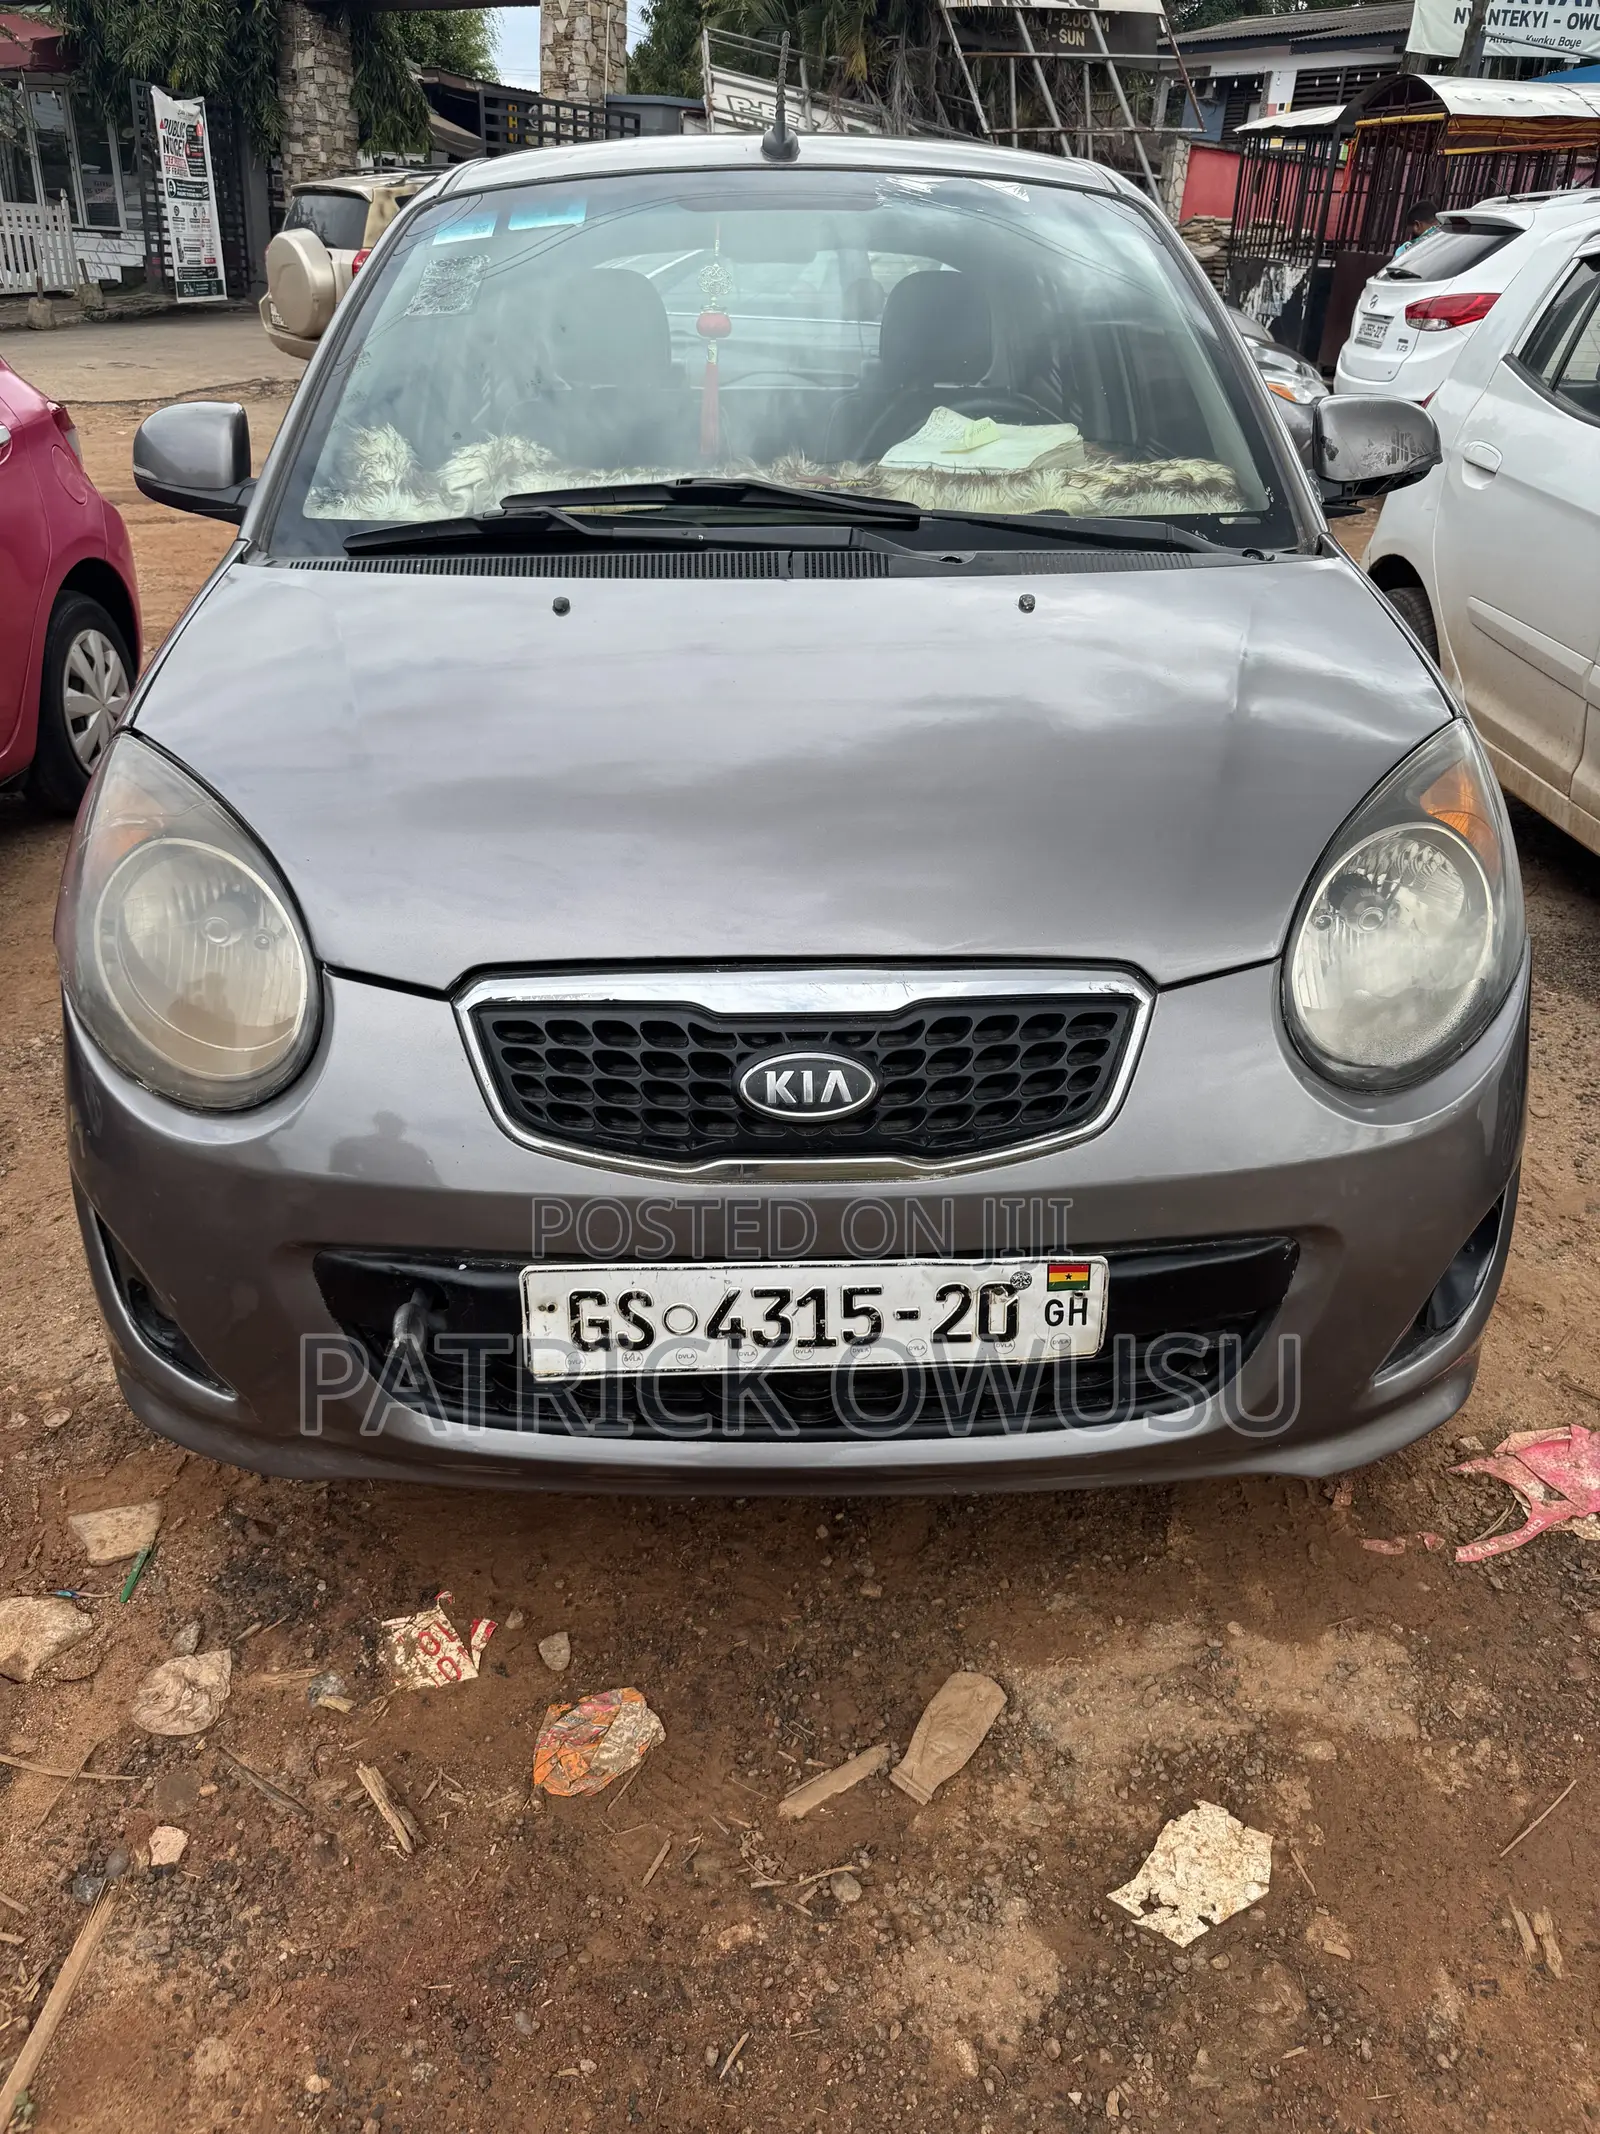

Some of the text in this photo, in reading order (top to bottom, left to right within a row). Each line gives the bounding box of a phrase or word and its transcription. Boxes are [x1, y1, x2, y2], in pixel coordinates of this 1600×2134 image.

[1454, 7, 1549, 29] NNTEKYI
[1059, 28, 1085, 47] SUN
[1558, 36, 1582, 49] Boye
[764, 1069, 853, 1104] KIA
[568, 1281, 1019, 1352] GS 4315-20
[1044, 1297, 1089, 1327] GH
